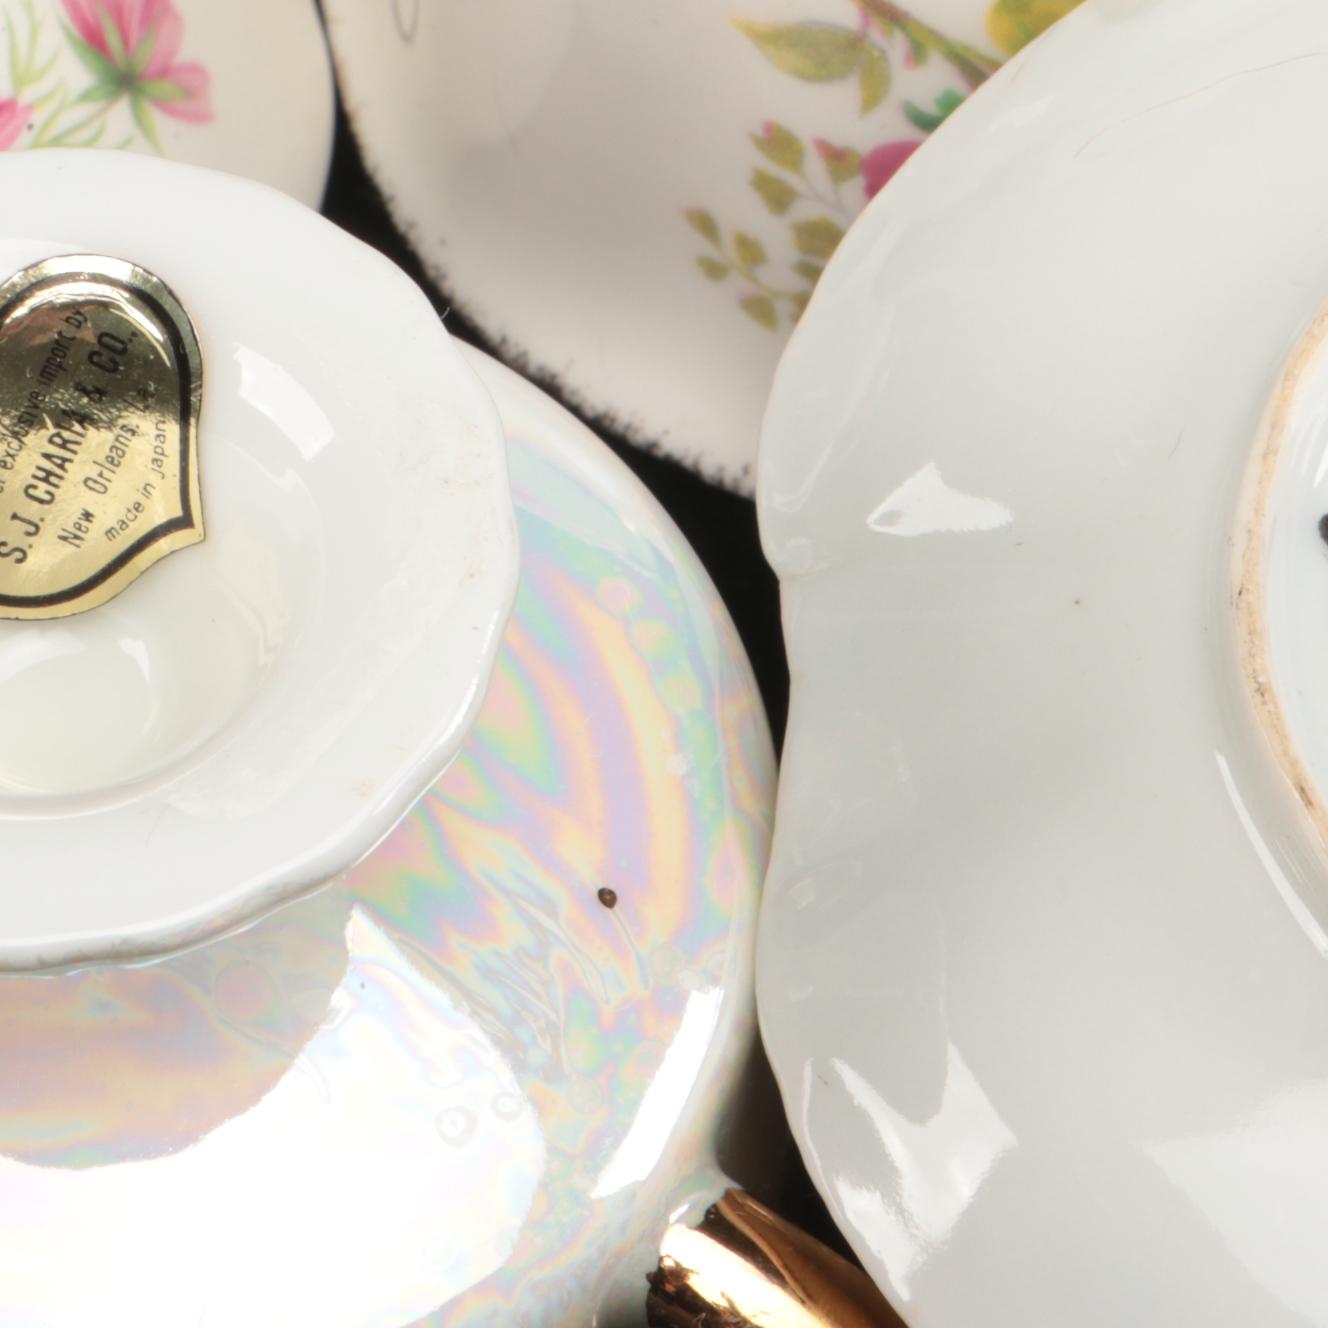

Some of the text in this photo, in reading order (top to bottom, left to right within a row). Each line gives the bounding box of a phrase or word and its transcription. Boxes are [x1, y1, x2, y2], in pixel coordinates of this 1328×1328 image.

[39, 330, 78, 404] import
[64, 305, 89, 332] by
[57, 508, 97, 550] New
[104, 420, 168, 543] made in japan
